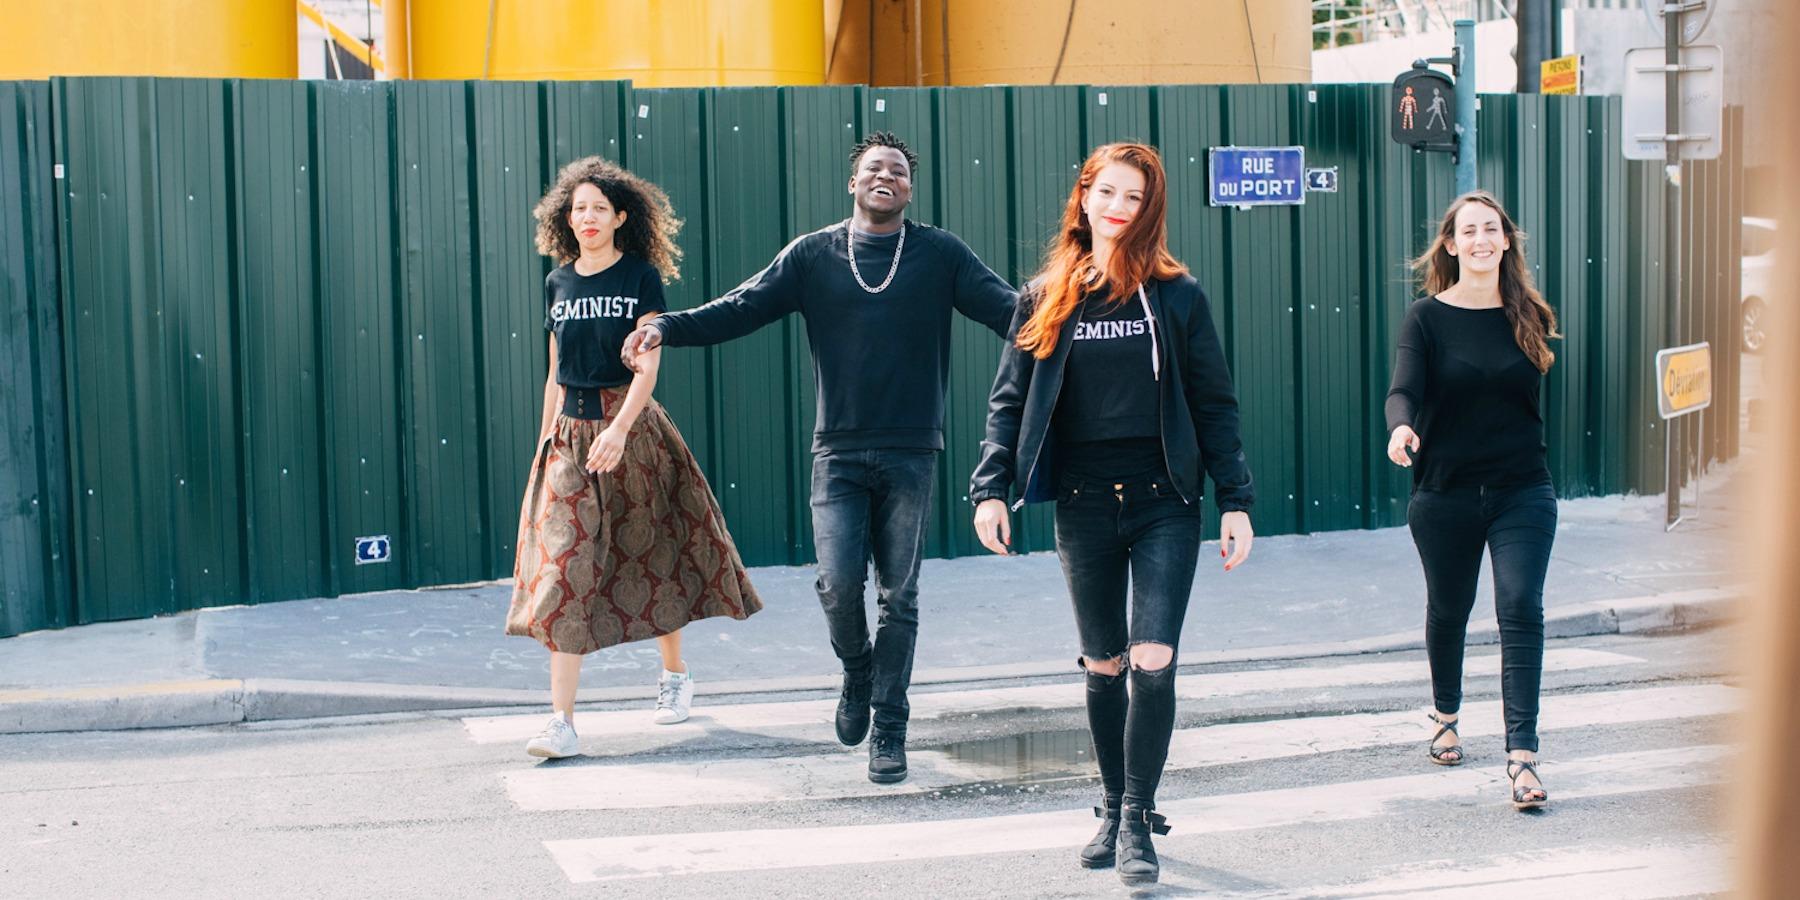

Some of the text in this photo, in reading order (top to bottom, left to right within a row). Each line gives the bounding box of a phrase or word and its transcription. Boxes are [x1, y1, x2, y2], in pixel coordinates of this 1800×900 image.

[1242, 158, 1274, 173] RUE
[1316, 172, 1328, 187] 4
[1219, 180, 1295, 196] DU PORT
[551, 296, 639, 321] EMINIST
[367, 540, 381, 558] 4
